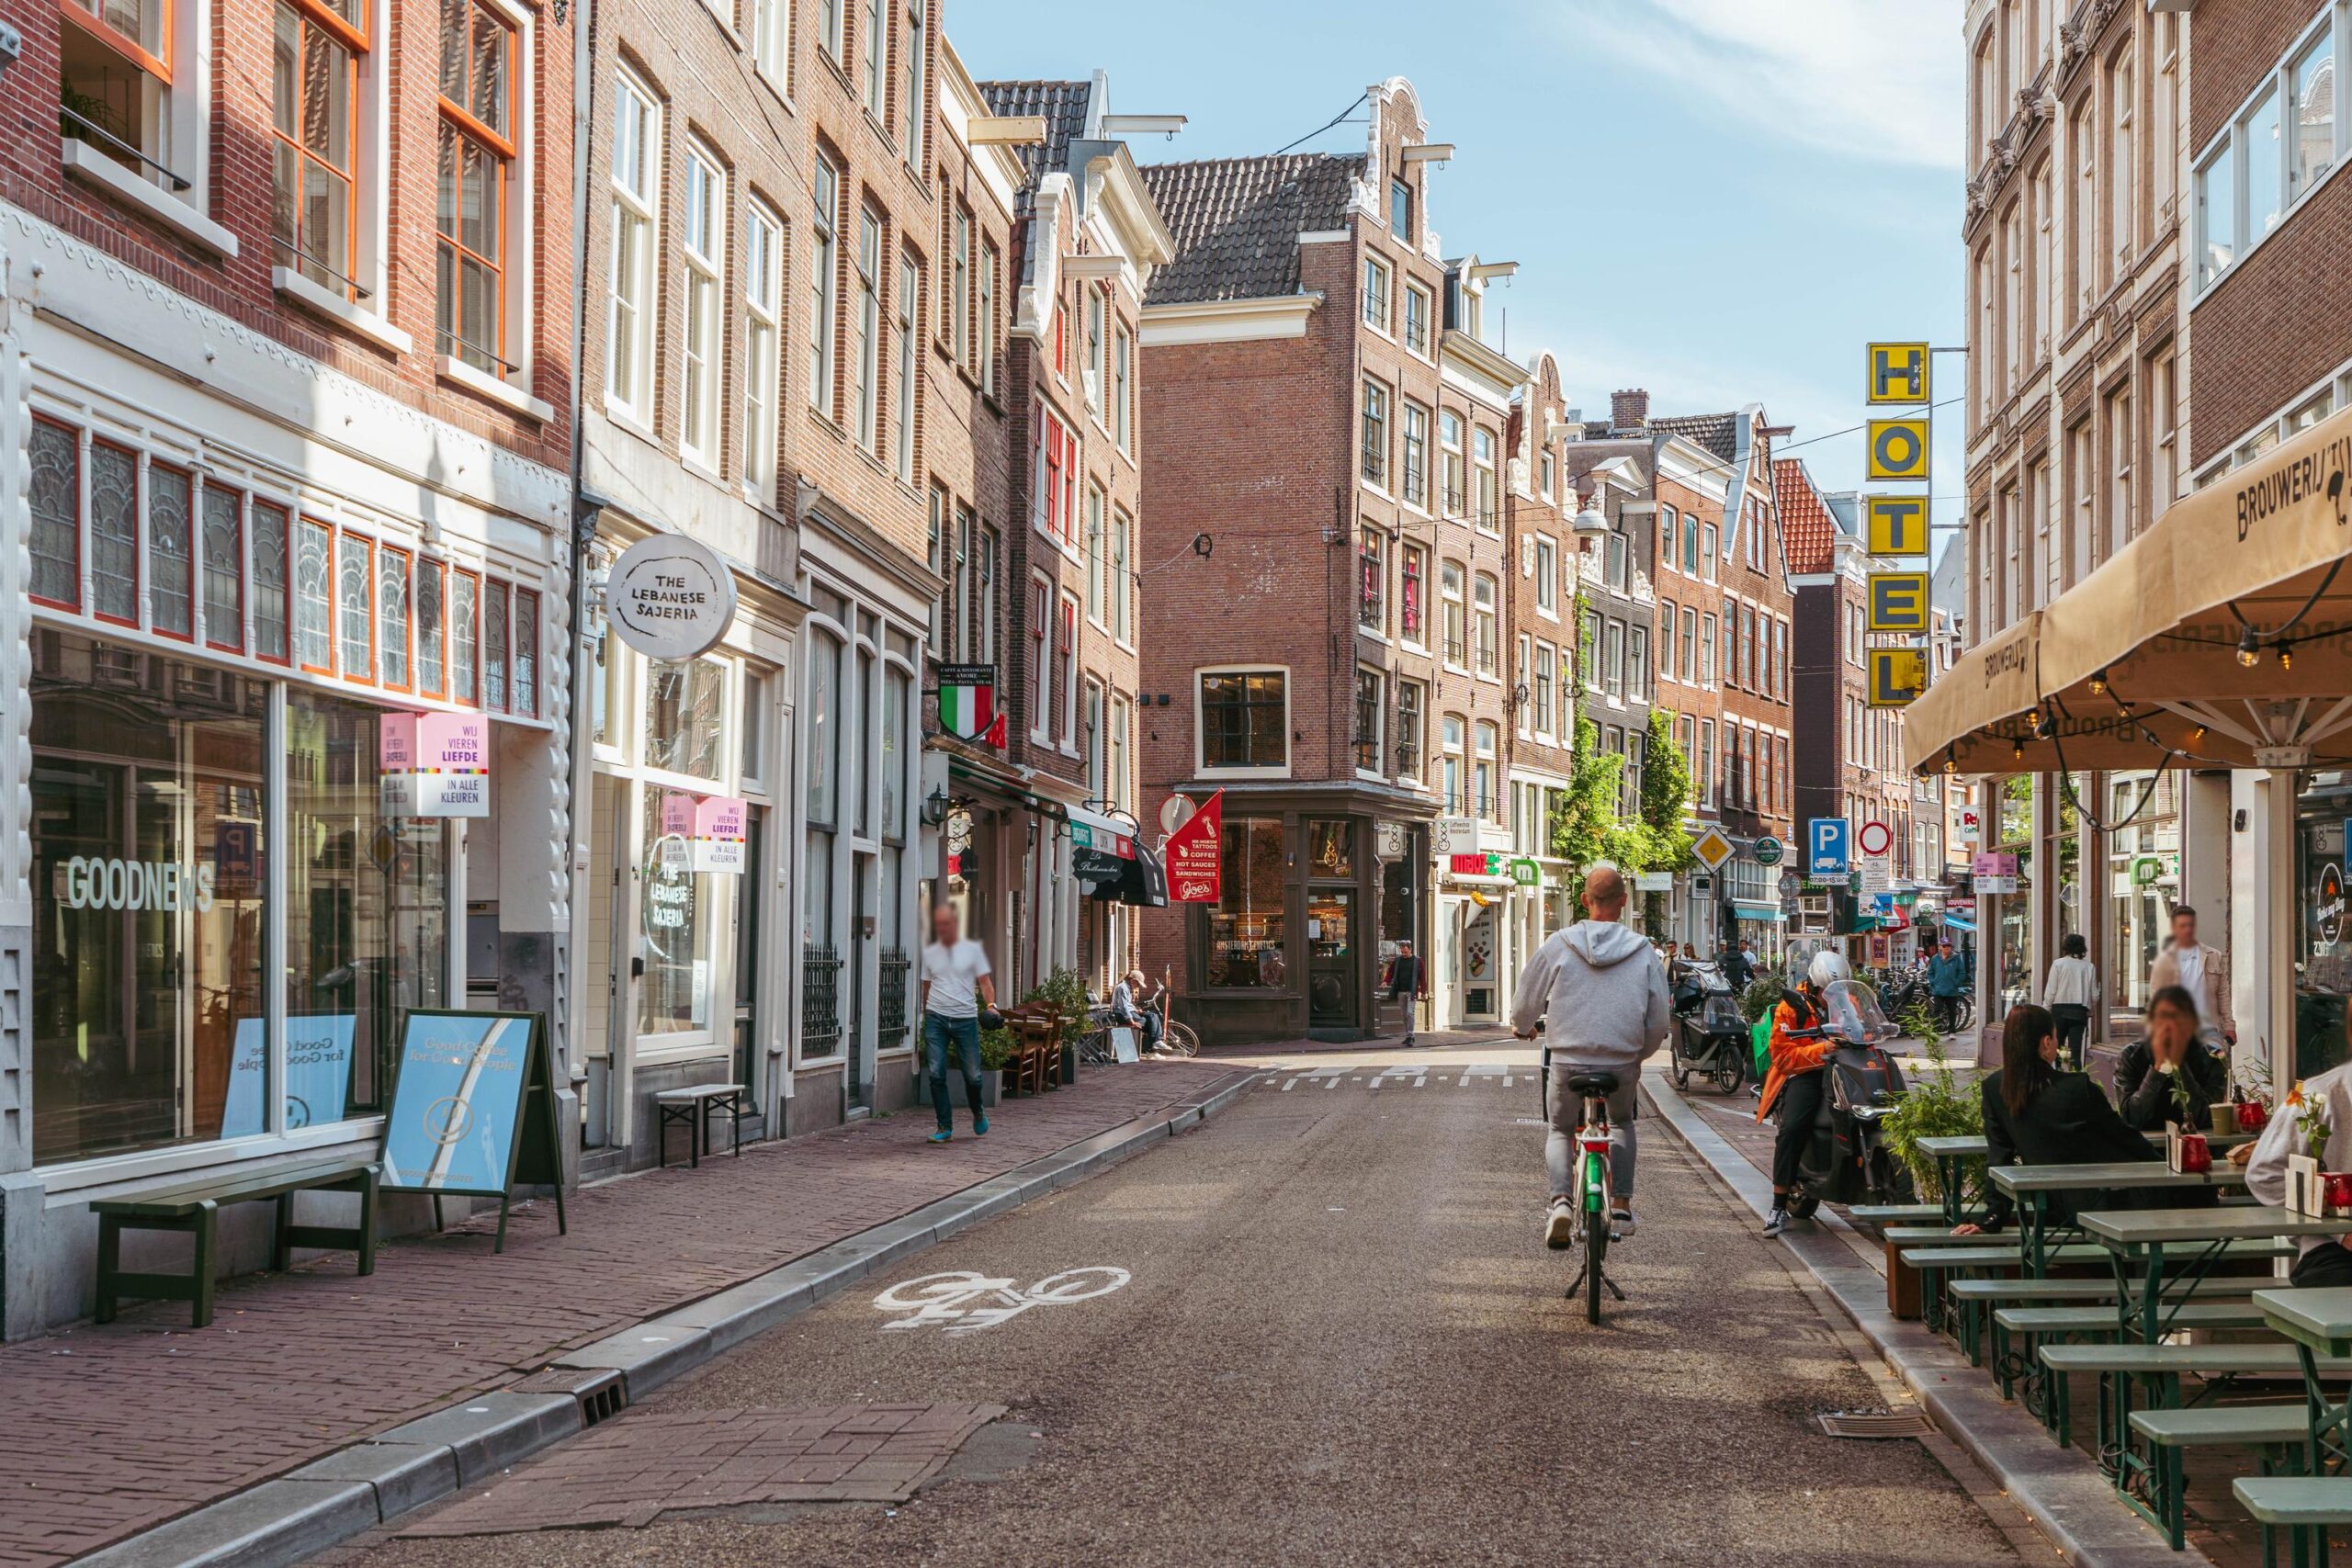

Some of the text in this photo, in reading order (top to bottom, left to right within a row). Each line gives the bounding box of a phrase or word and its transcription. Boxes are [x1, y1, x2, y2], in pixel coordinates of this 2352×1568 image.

[2237, 448, 2326, 543] BROUWERIJ
[1875, 350, 1921, 701] HOTEL
[655, 575, 685, 588] THE
[631, 588, 706, 604] LEBANESE
[636, 603, 699, 620] SAJERIA
[462, 726, 478, 737] WIJ
[447, 739, 478, 750] VIEREN
[442, 751, 478, 762] LIEFDE
[447, 779, 478, 790] IN ALLE
[441, 793, 479, 804] KLEUREN
[728, 807, 740, 817] WIJ
[718, 815, 739, 825] VIEREN
[712, 825, 739, 834] LIEFDE
[1819, 825, 1838, 852] P
[715, 844, 738, 854] IN ALLE
[710, 854, 738, 863] KLEUREN
[662, 862, 679, 880] THE
[68, 855, 213, 913] GOODNEWS
[1182, 881, 1210, 899] Joe's
[650, 882, 688, 905] LEBANESE
[653, 904, 684, 927] SAJERIA
[425, 1037, 508, 1055] Good Coffee
[408, 1048, 427, 1062] for
